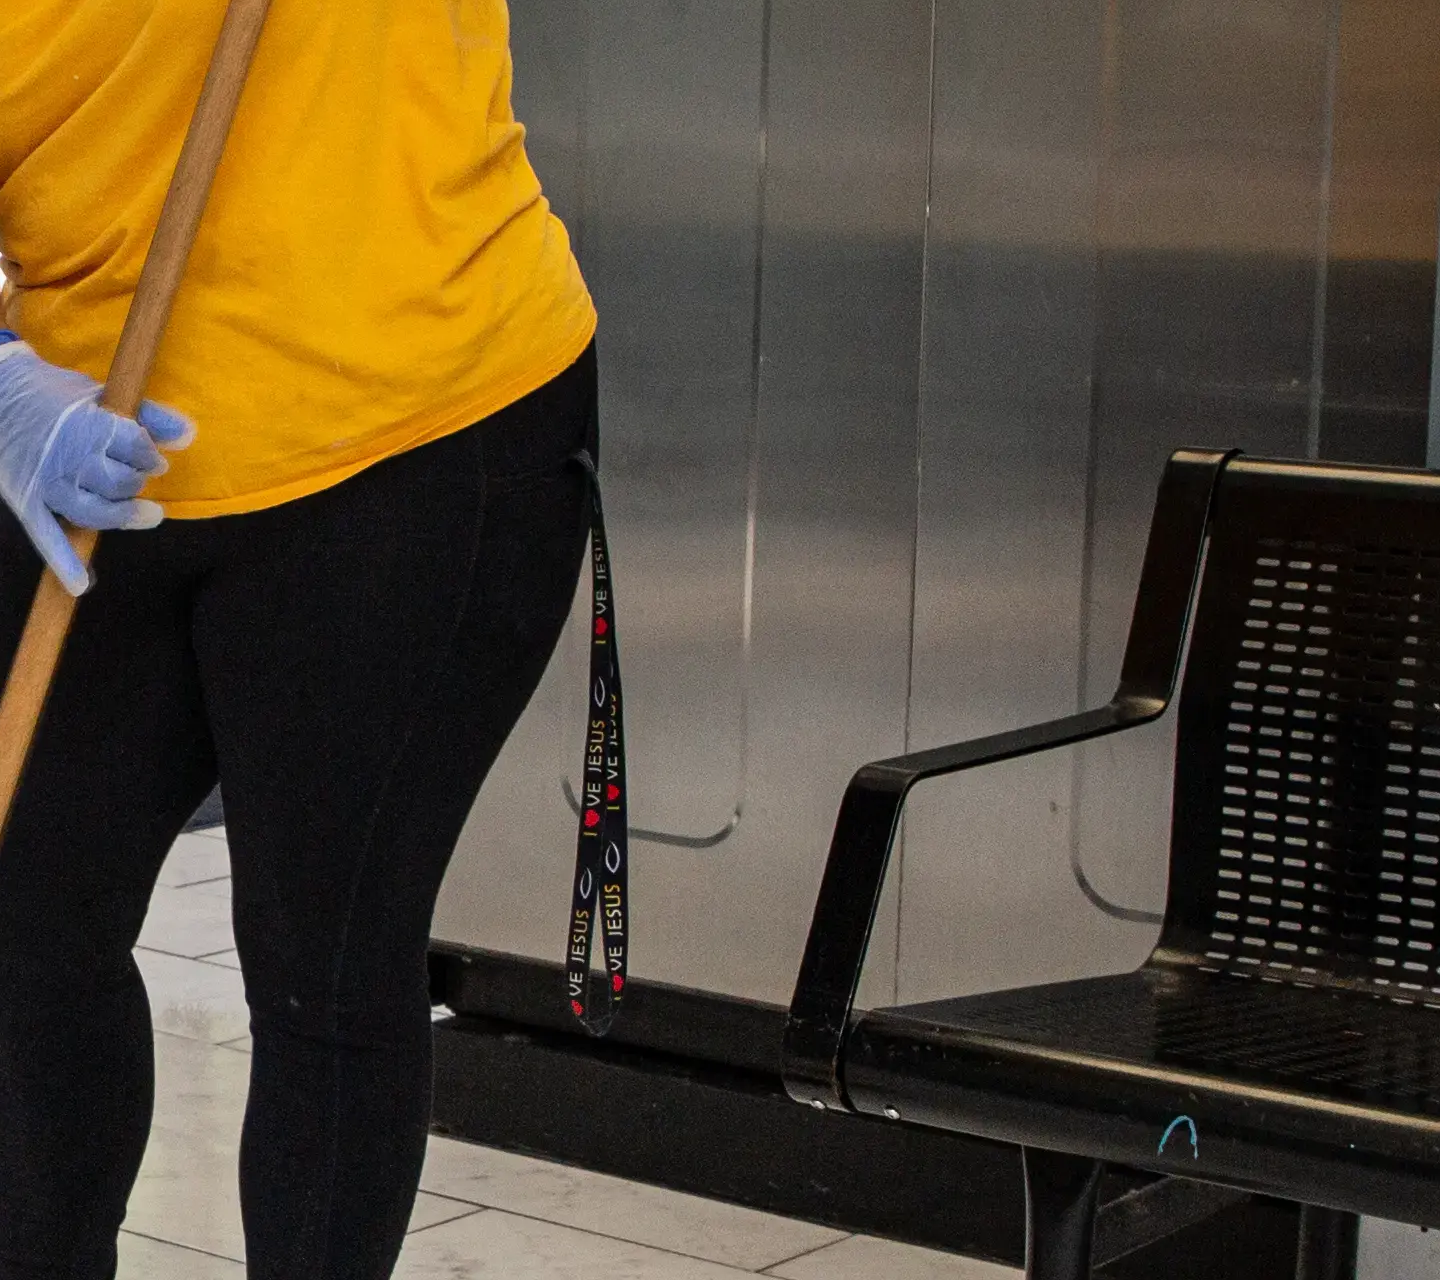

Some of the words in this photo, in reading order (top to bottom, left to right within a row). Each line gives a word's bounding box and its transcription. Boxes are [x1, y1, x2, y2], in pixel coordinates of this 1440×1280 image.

[588, 720, 605, 773] JESUS
[571, 909, 589, 963] JESUS
[604, 884, 624, 936] JESUS
